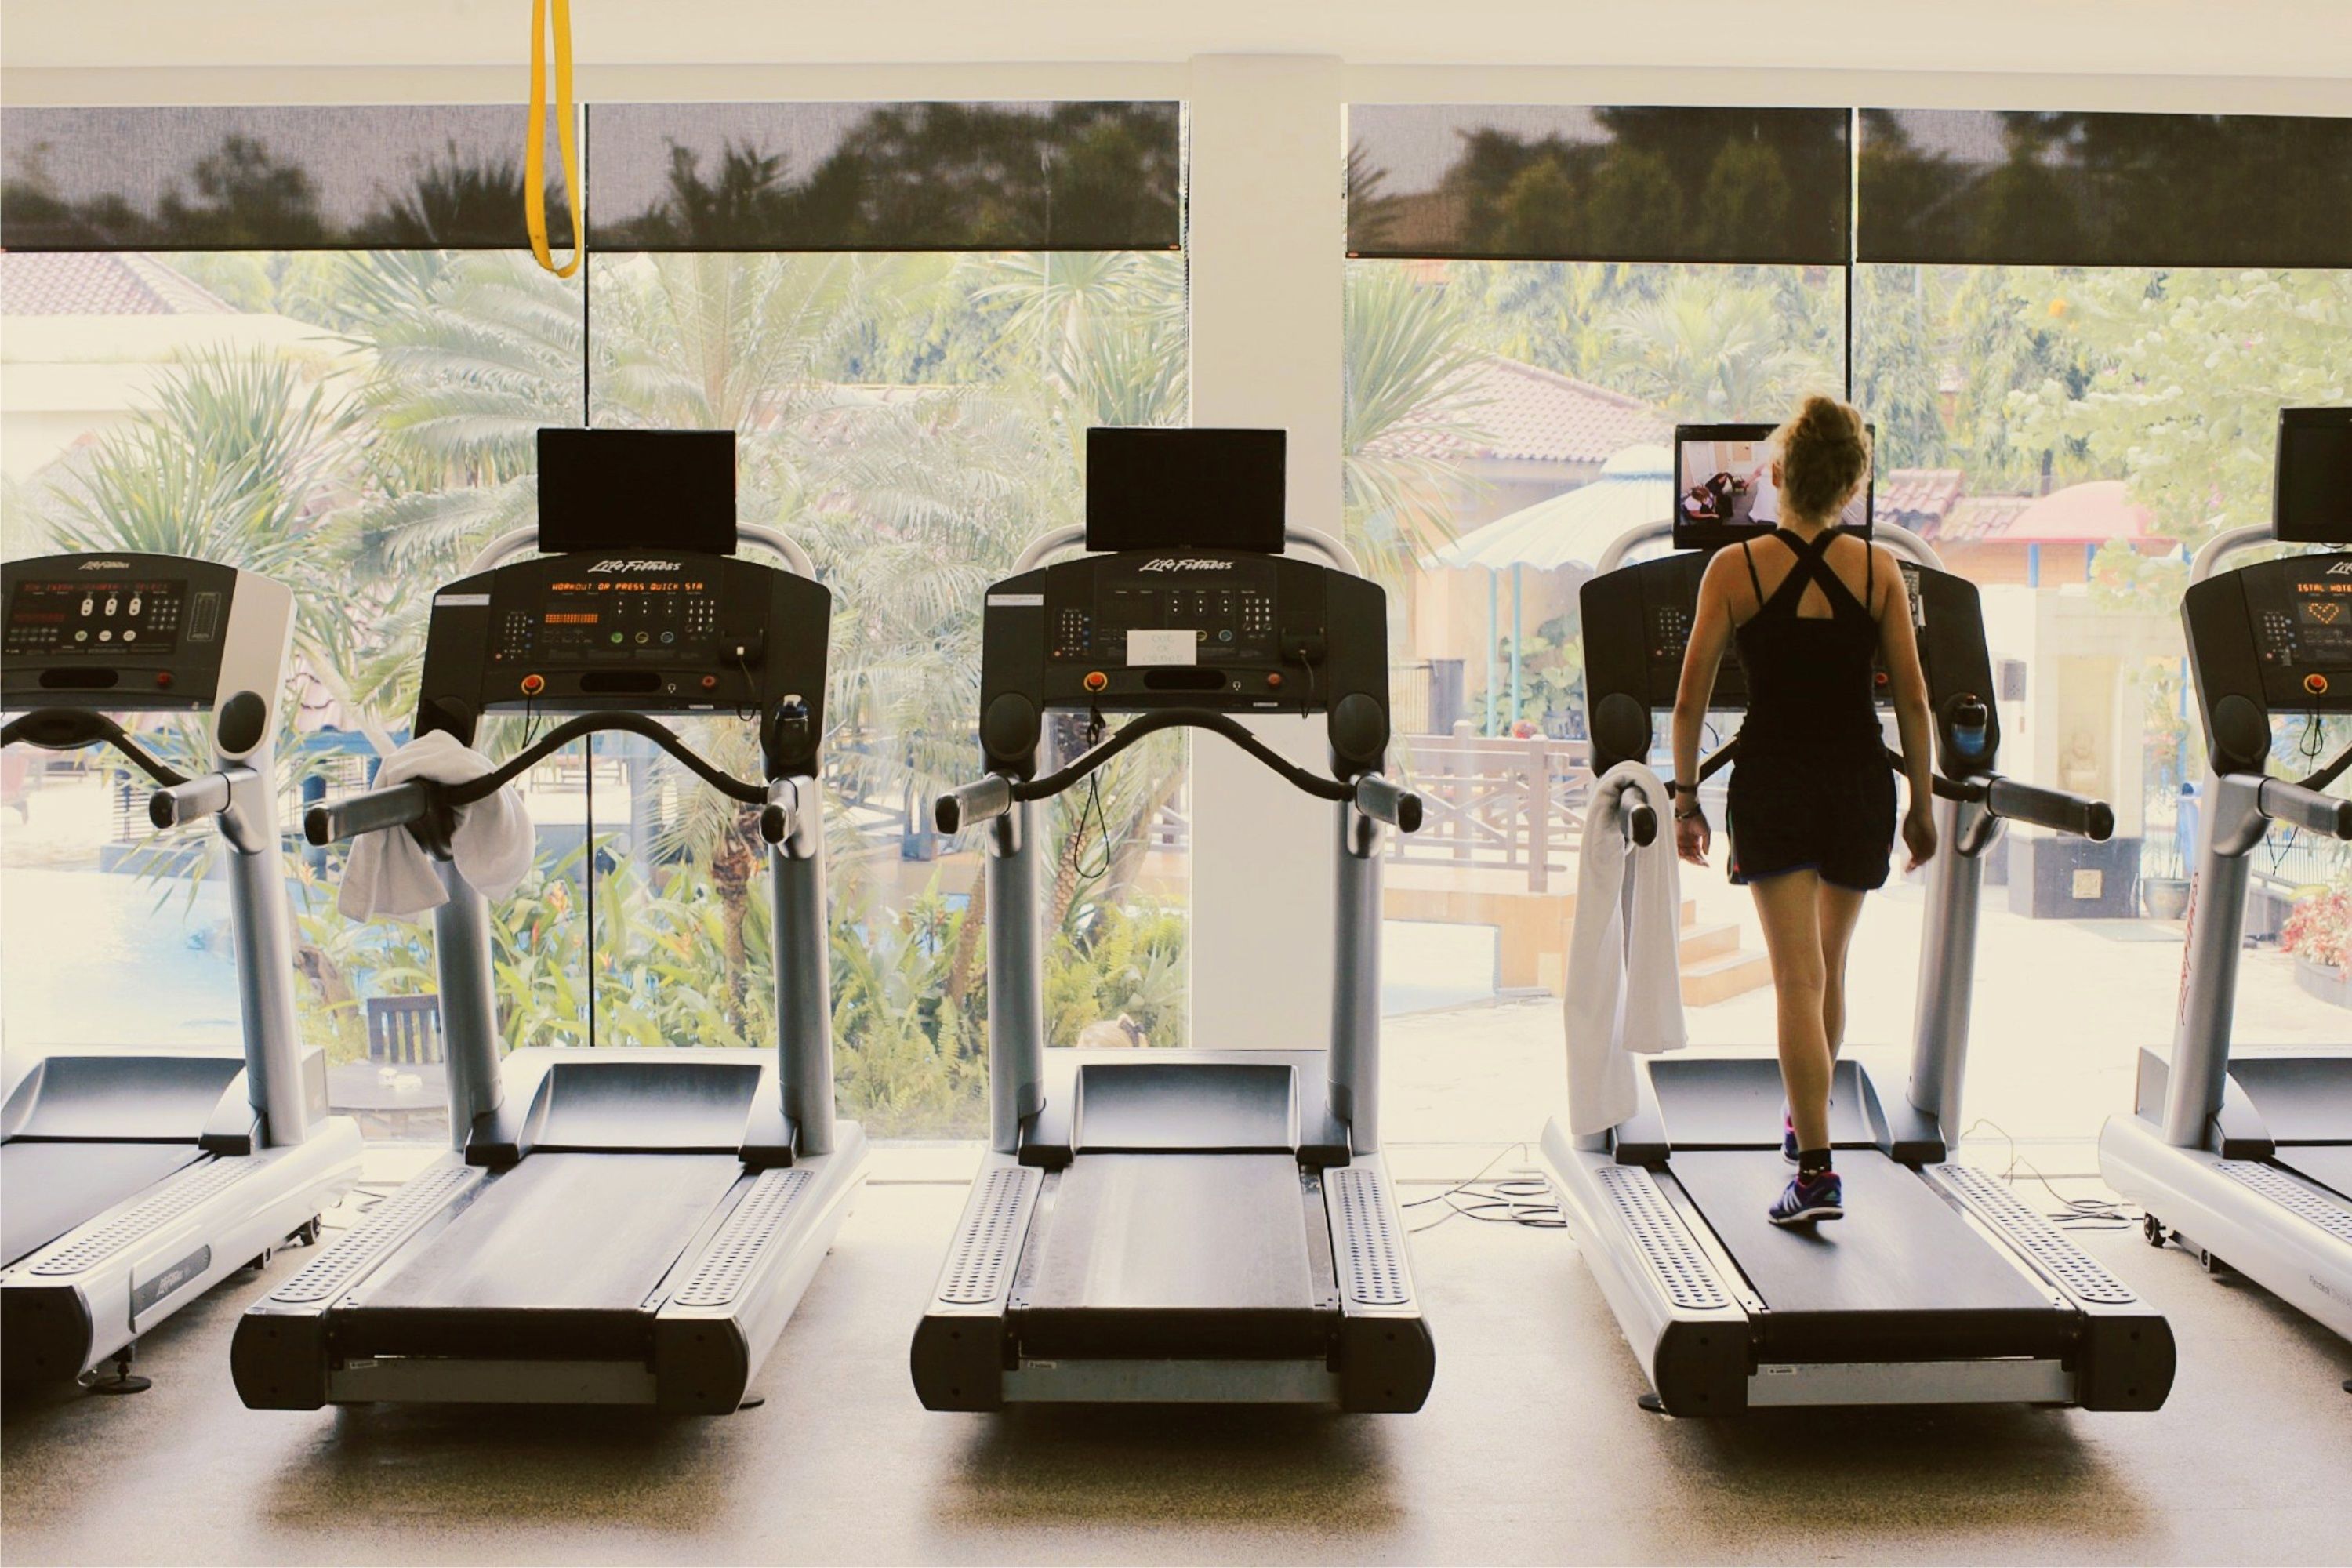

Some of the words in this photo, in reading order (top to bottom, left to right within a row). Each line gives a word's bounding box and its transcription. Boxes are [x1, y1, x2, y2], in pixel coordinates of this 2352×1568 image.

[587, 560, 624, 573] Life
[621, 560, 682, 573] Fitness
[1139, 558, 1175, 572] Life
[1173, 558, 1234, 572] Fitness
[2326, 561, 2352, 575] Lif
